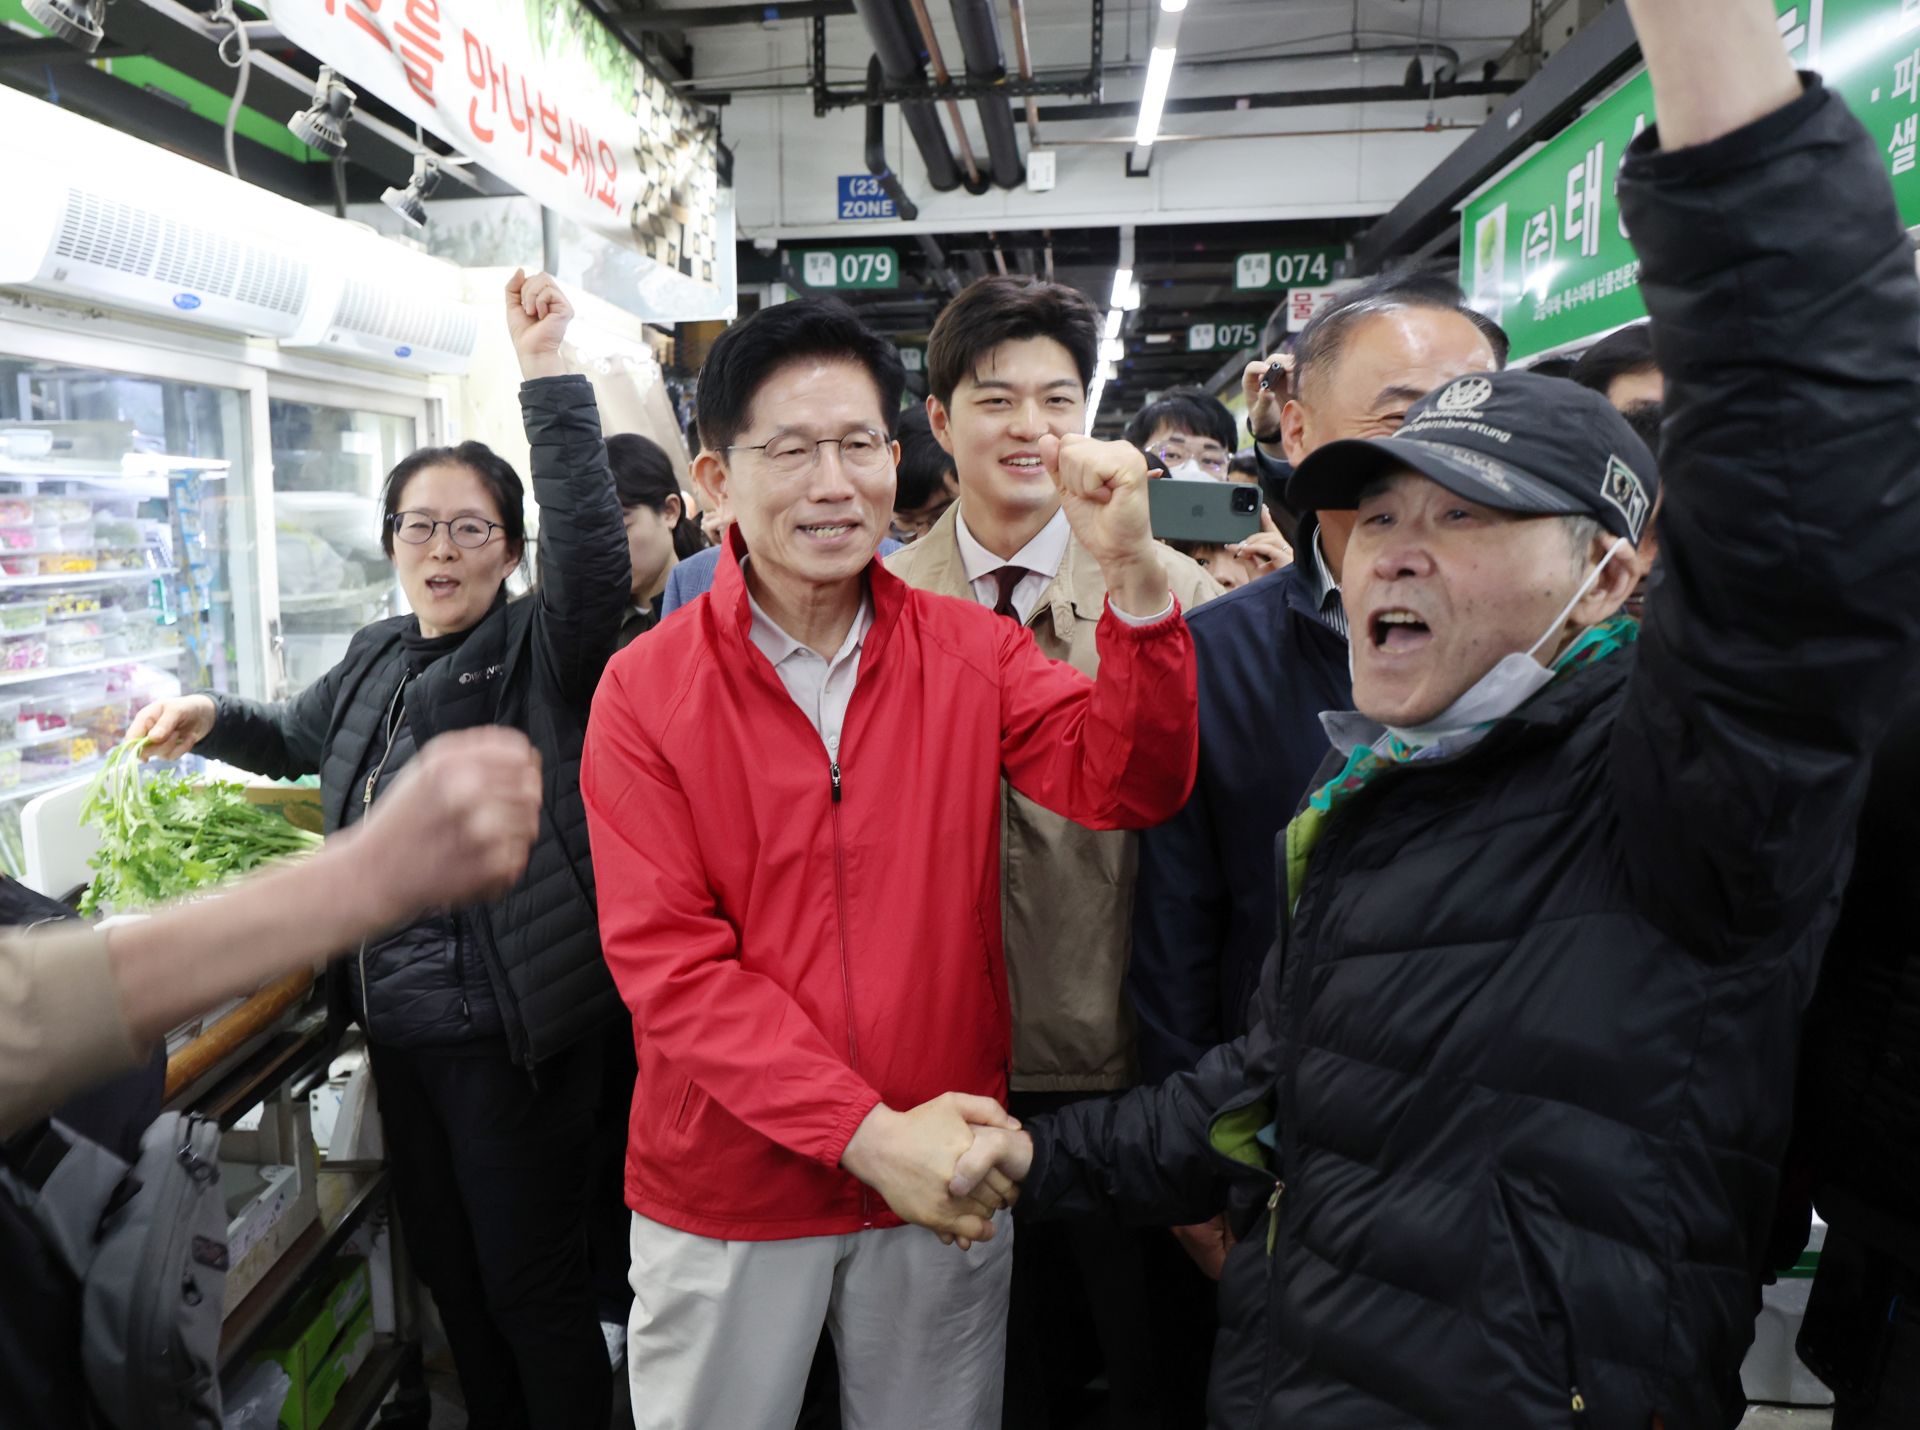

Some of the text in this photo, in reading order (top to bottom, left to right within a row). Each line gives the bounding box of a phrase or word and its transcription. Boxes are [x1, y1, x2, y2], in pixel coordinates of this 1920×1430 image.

[842, 199, 893, 218] ZONE
[841, 253, 892, 283] 079
[1275, 253, 1328, 283] 074
[1216, 322, 1257, 347] 075
